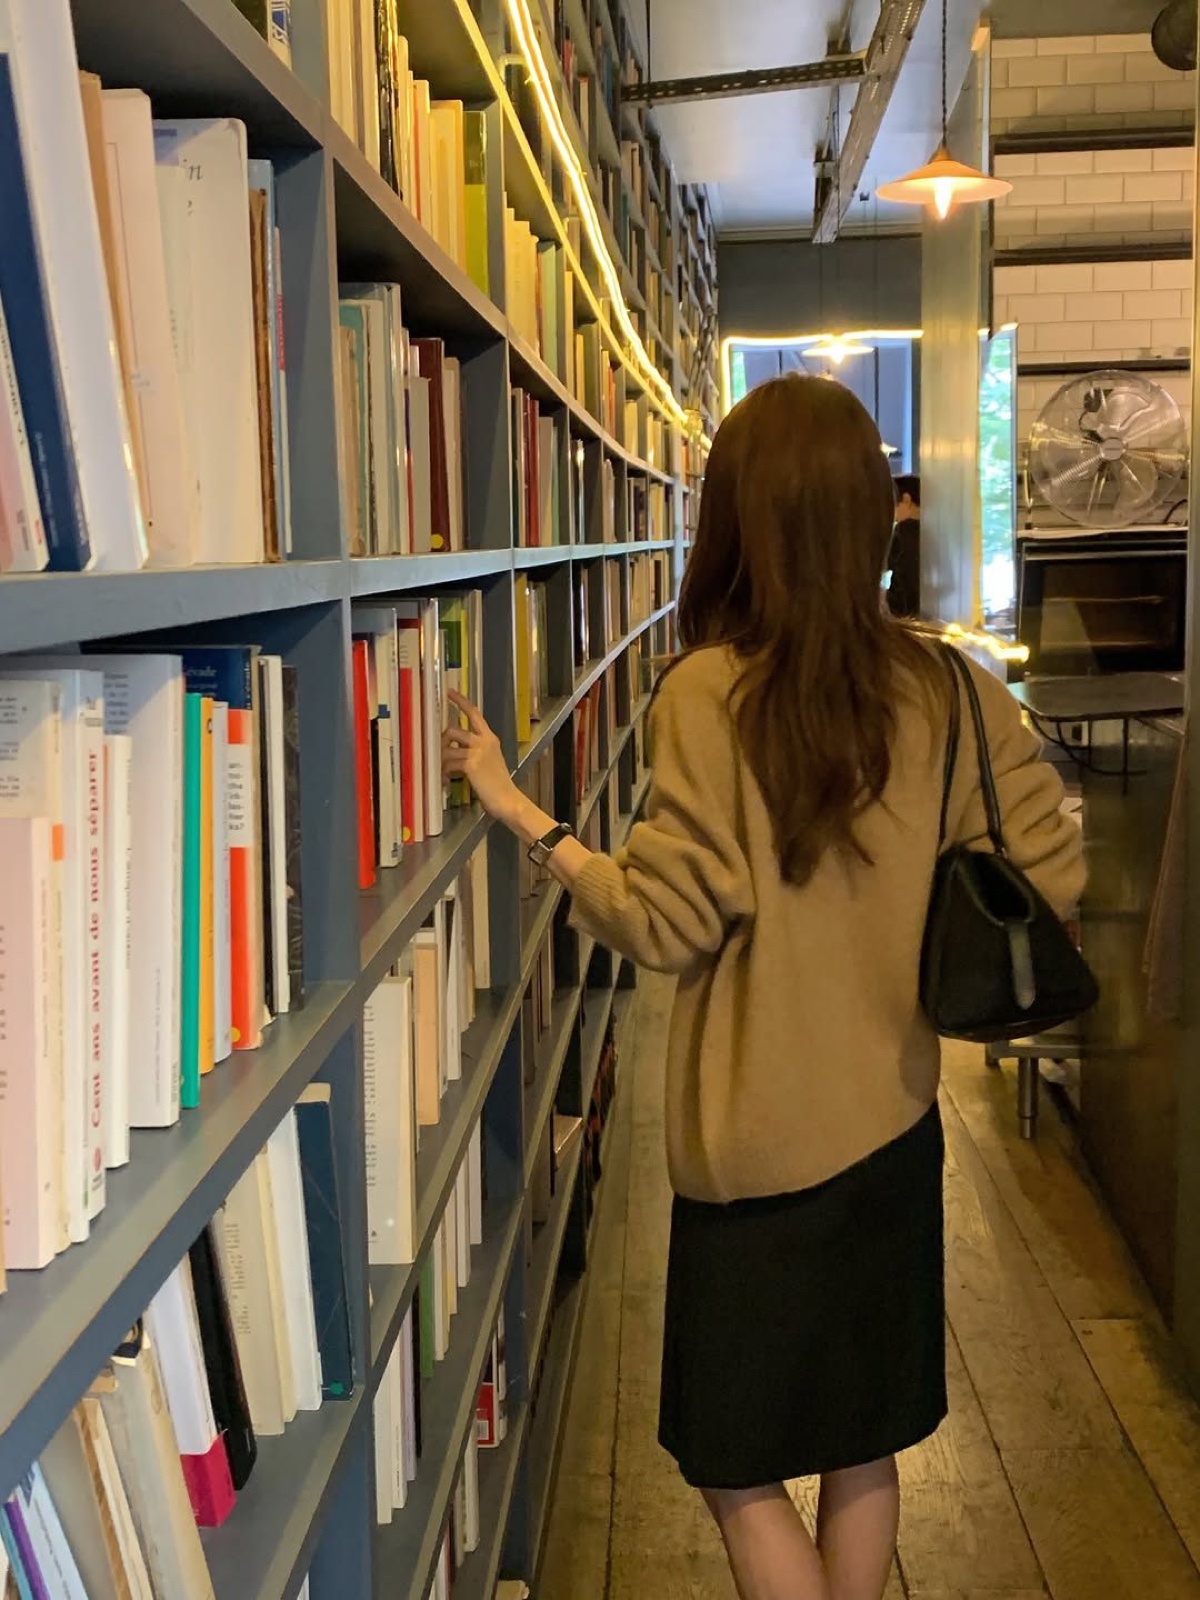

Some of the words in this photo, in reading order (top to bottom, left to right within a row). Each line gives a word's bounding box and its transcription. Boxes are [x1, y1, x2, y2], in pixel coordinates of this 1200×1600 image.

[88, 748, 99, 836] séparer
[90, 847, 99, 902] nous
[90, 912, 99, 940] de
[91, 951, 100, 1013] avant
[92, 1022, 101, 1062] ans
[91, 1074, 101, 1128] Cent
